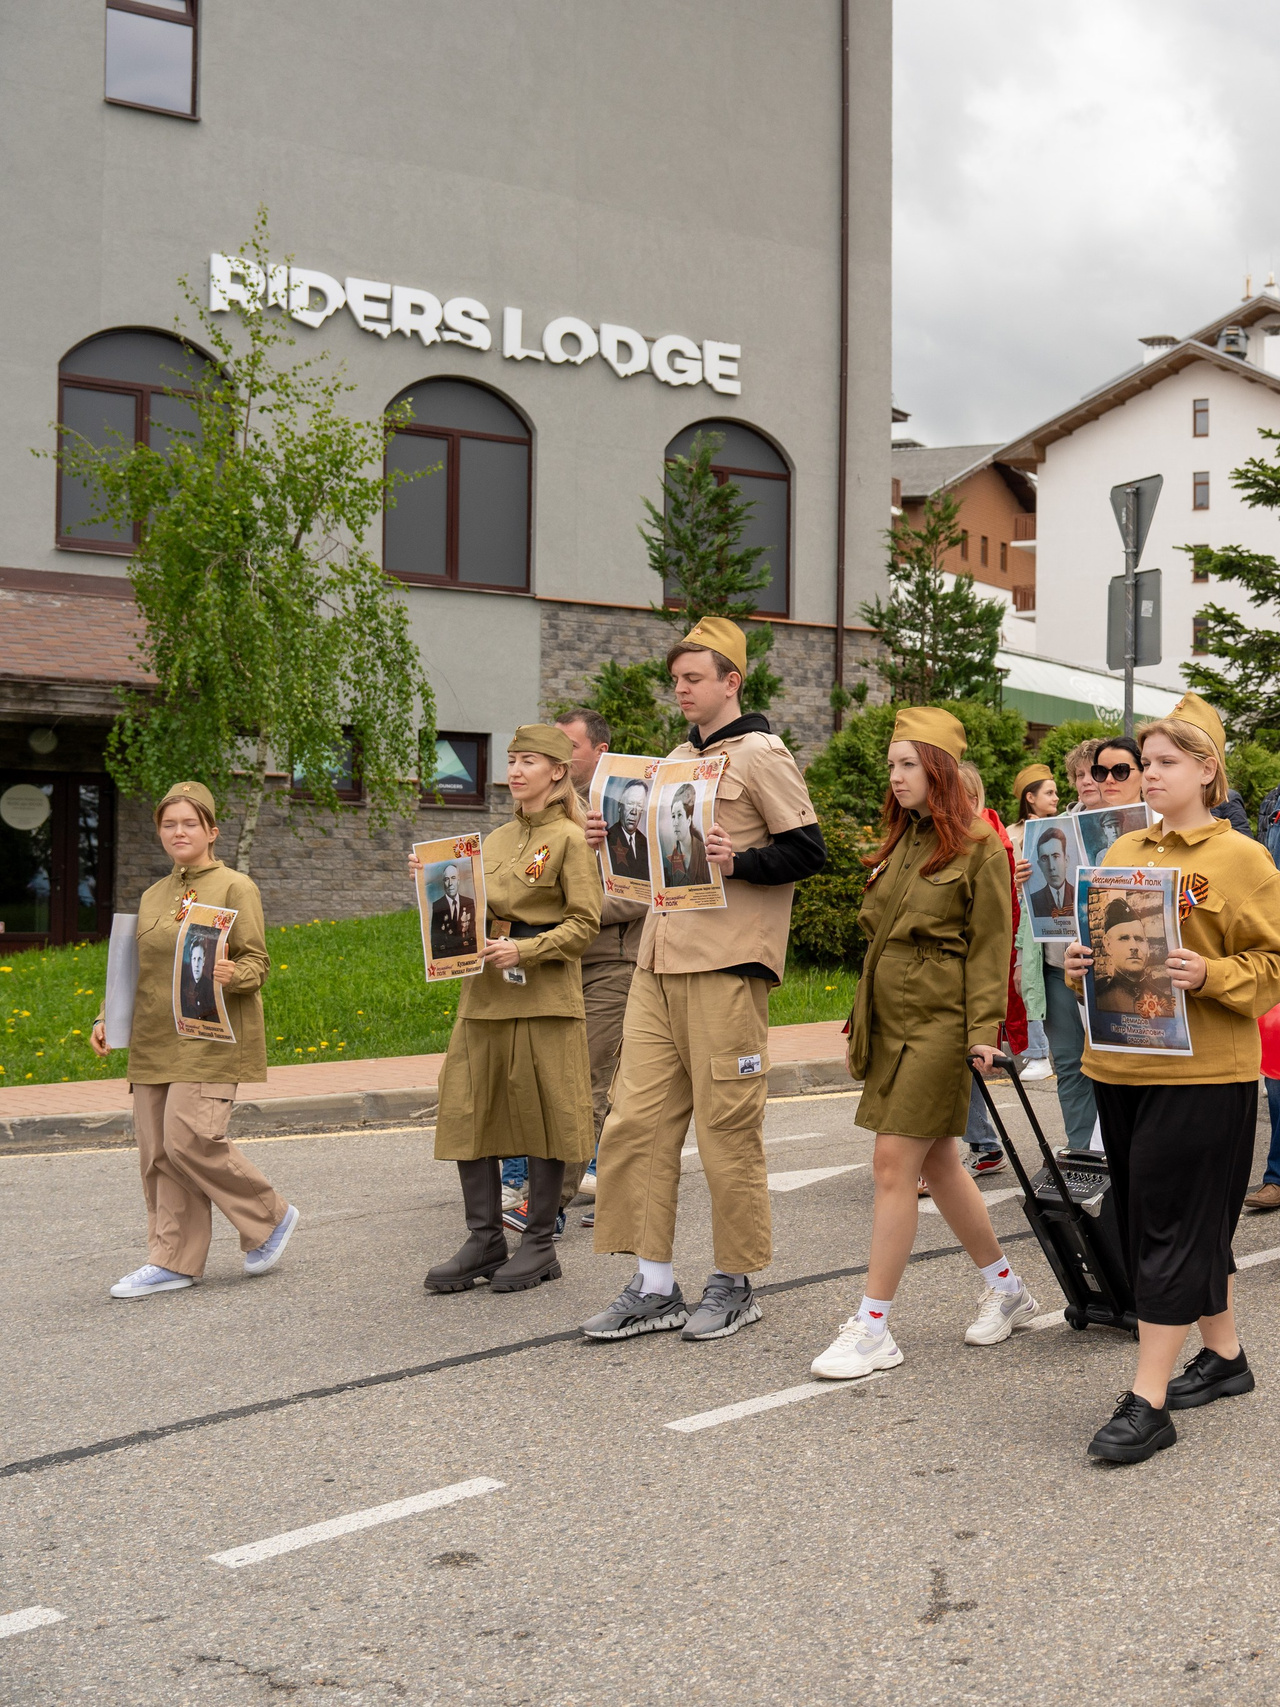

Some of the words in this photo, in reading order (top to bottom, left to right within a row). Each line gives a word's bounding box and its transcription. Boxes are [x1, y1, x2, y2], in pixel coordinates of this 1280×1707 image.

[209, 252, 492, 352] RIDERS
[503, 306, 742, 396] LODGE
[1041, 928, 1063, 936] Николай
[1121, 1015, 1149, 1026] Демидов
[1126, 1025, 1166, 1038] Михайлович
